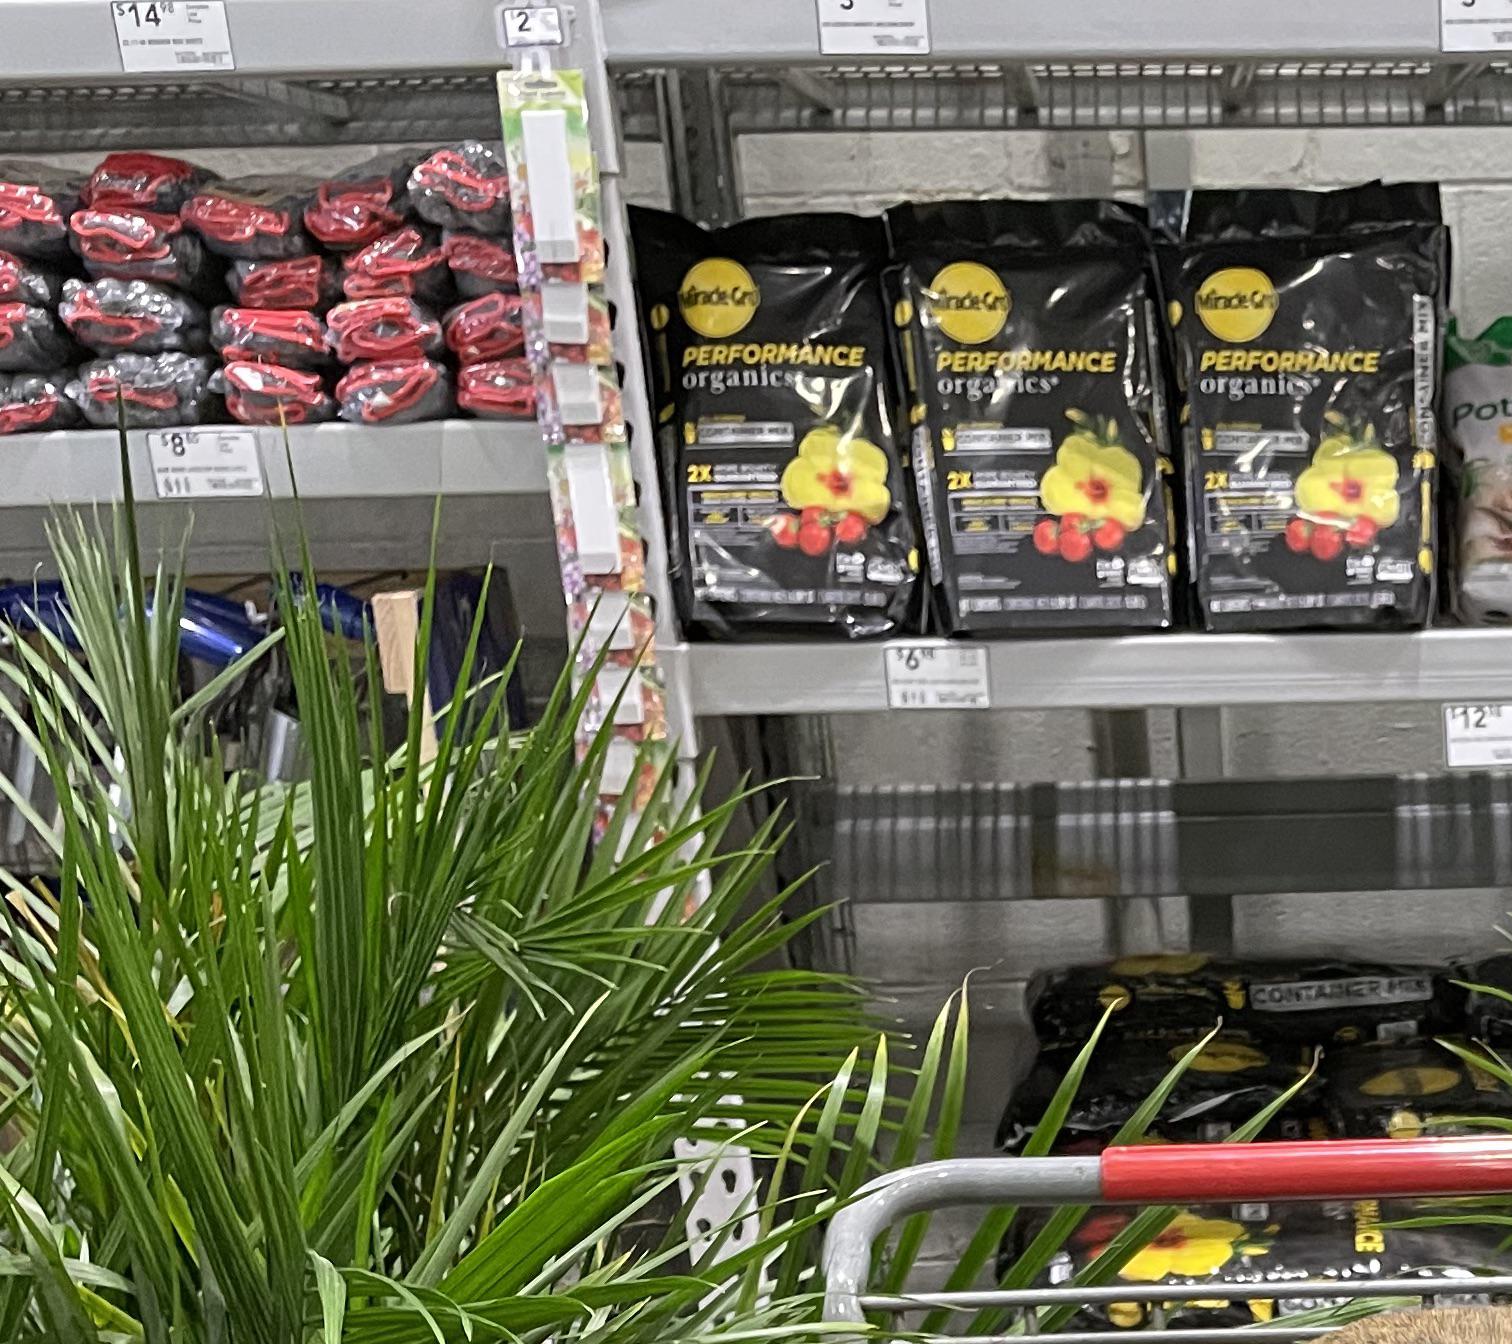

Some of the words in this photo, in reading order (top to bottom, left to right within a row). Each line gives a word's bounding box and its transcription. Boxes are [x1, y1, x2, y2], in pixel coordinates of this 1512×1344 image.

[682, 343, 866, 367] PERFORMANCE
[936, 351, 1117, 372] PERFORMANCE
[1200, 350, 1381, 373] PERFORMANCE
